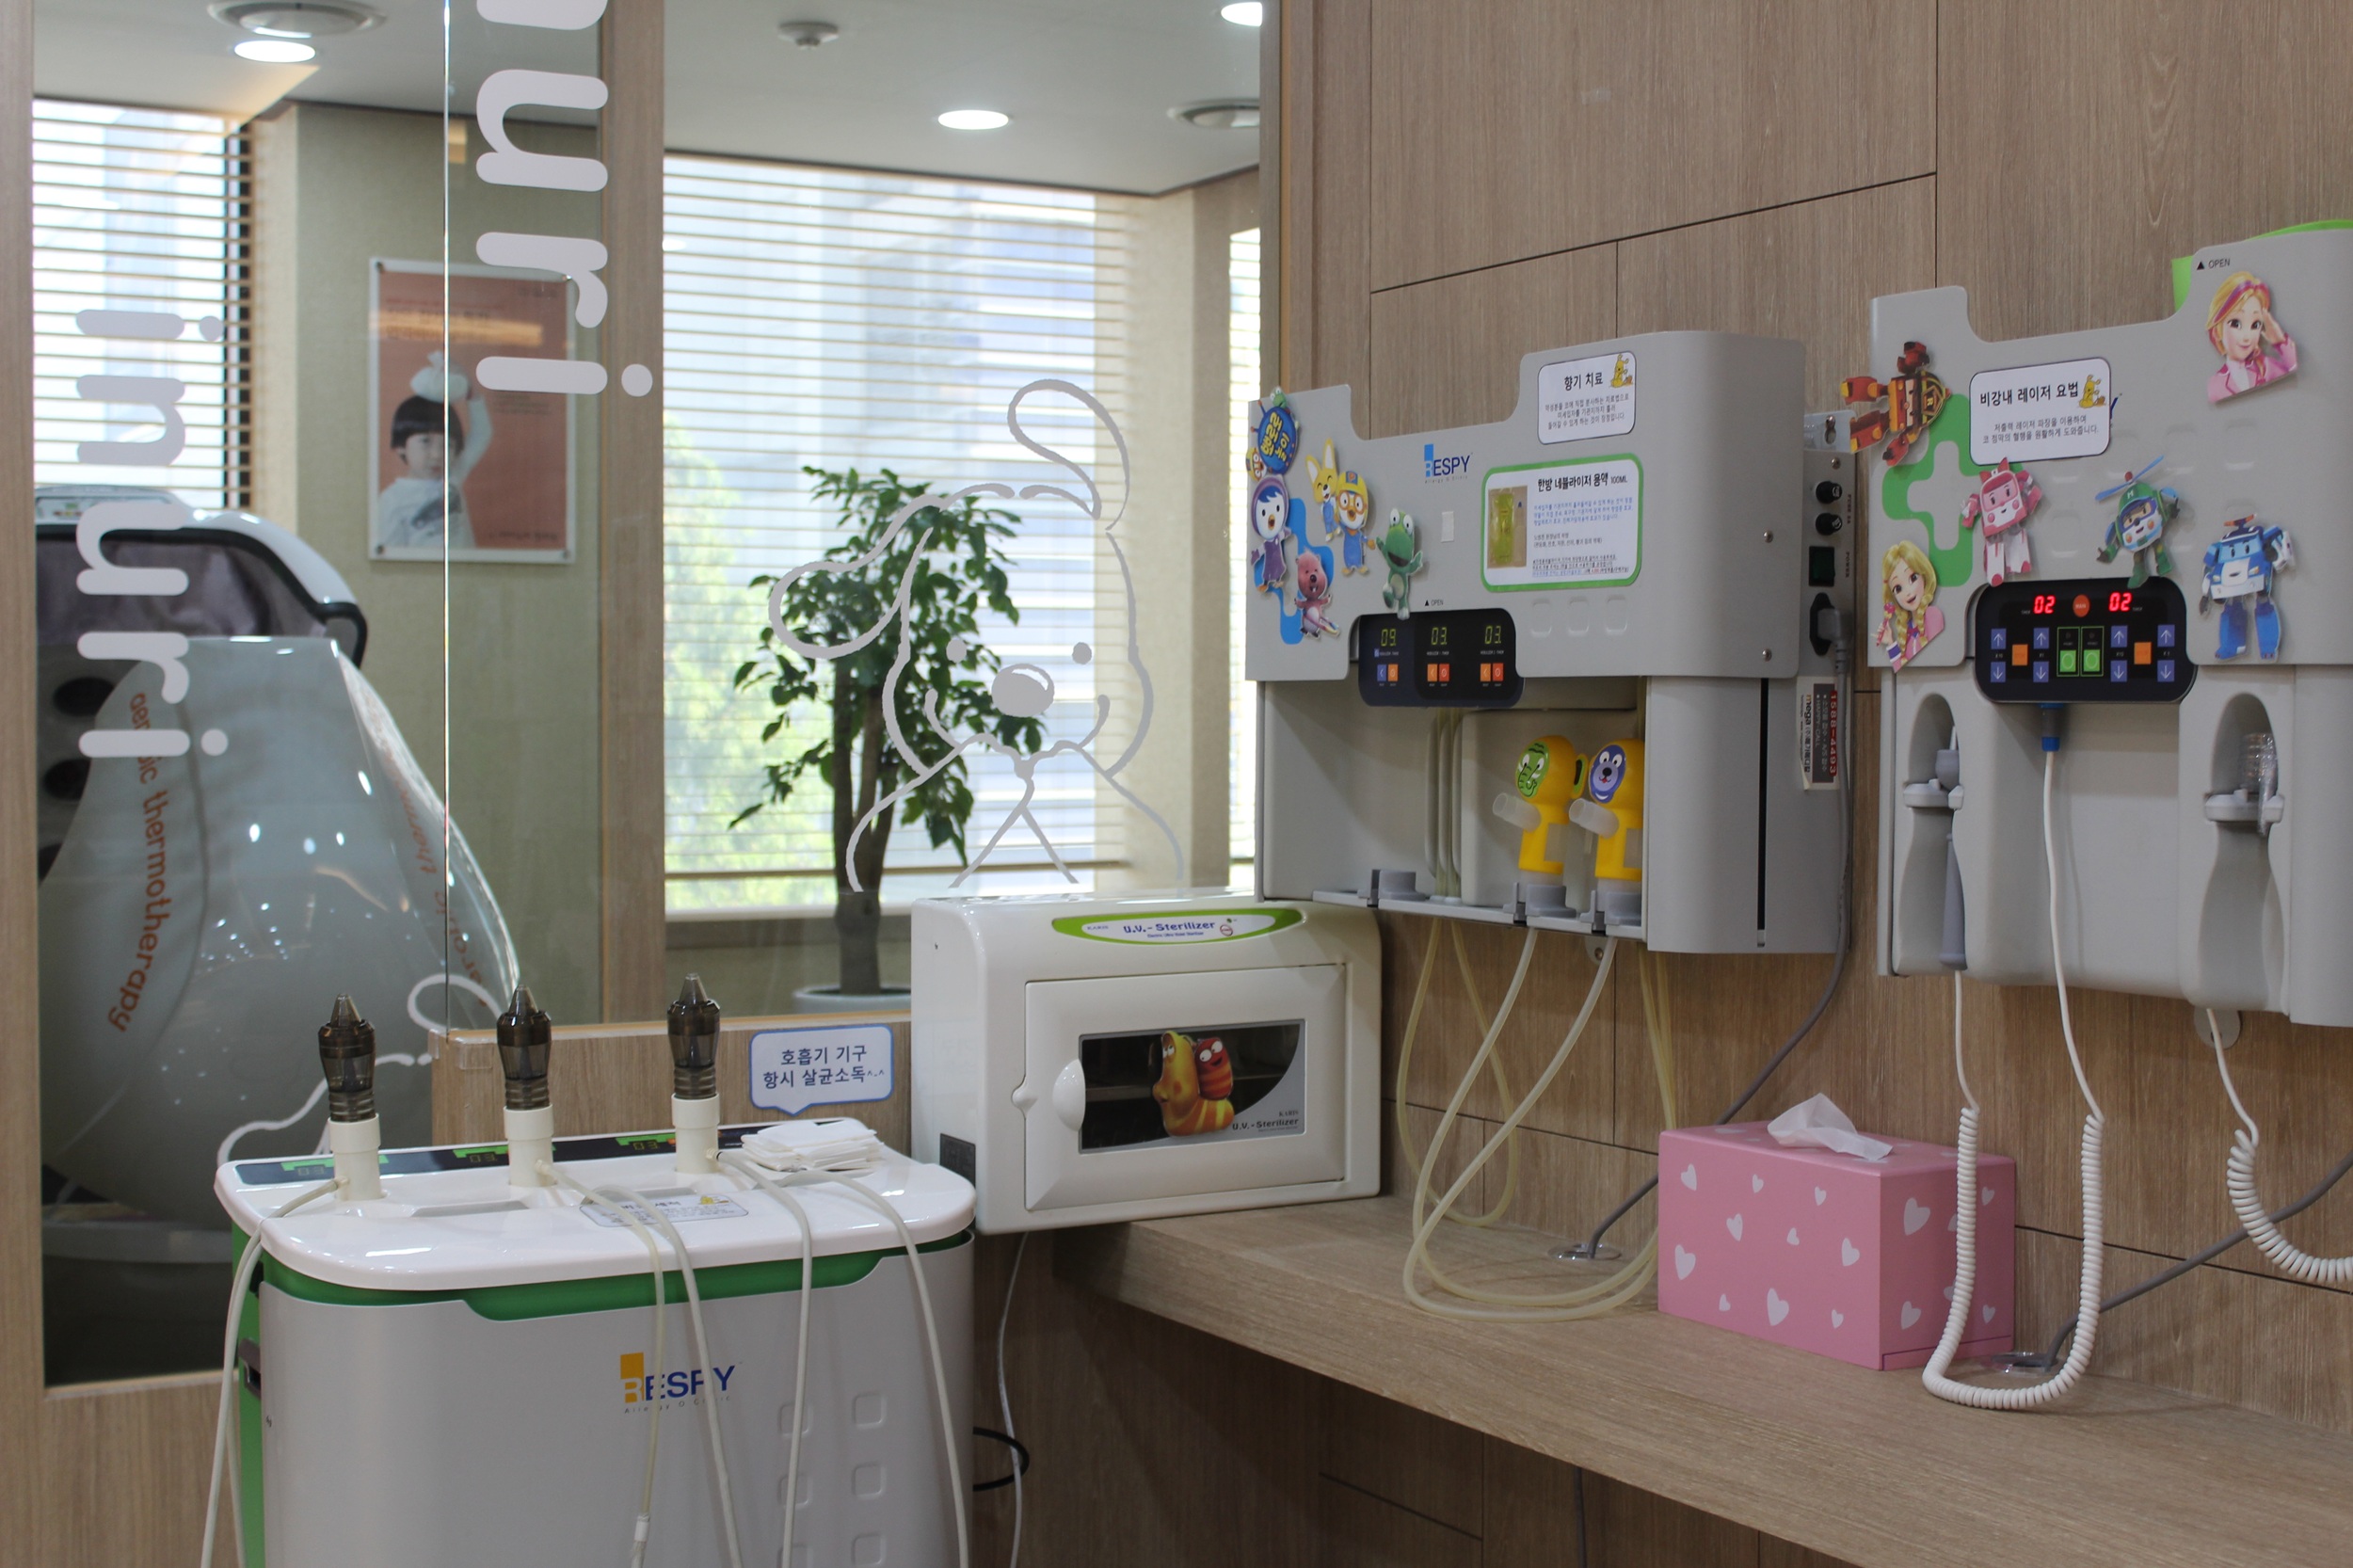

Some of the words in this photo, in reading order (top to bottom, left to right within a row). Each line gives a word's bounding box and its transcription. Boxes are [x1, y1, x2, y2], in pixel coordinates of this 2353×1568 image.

[2208, 258, 2231, 269] OPEN
[1564, 375, 1581, 392] 향기
[1585, 372, 1603, 388] 치료
[1979, 389, 2013, 408] 비강내
[2017, 384, 2051, 404] 레이저
[2056, 381, 2079, 398] 요법
[2015, 419, 2036, 430] 레이저
[2059, 414, 2088, 426] 이용하여
[1982, 435, 1990, 444] 코
[1538, 478, 1553, 492] 한방
[76, 309, 229, 758] inuri
[2034, 595, 2056, 614] 02
[2108, 592, 2133, 612] 02
[1803, 694, 1812, 726] mega
[130, 693, 161, 785] aeric
[108, 789, 172, 1032] thermotherapy
[1156, 921, 1216, 932] Sterilizer
[781, 1047, 828, 1065] 호흡기
[837, 1045, 868, 1063] 기구
[763, 1070, 794, 1089] 항시
[1257, 1118, 1299, 1128] Sterilizer
